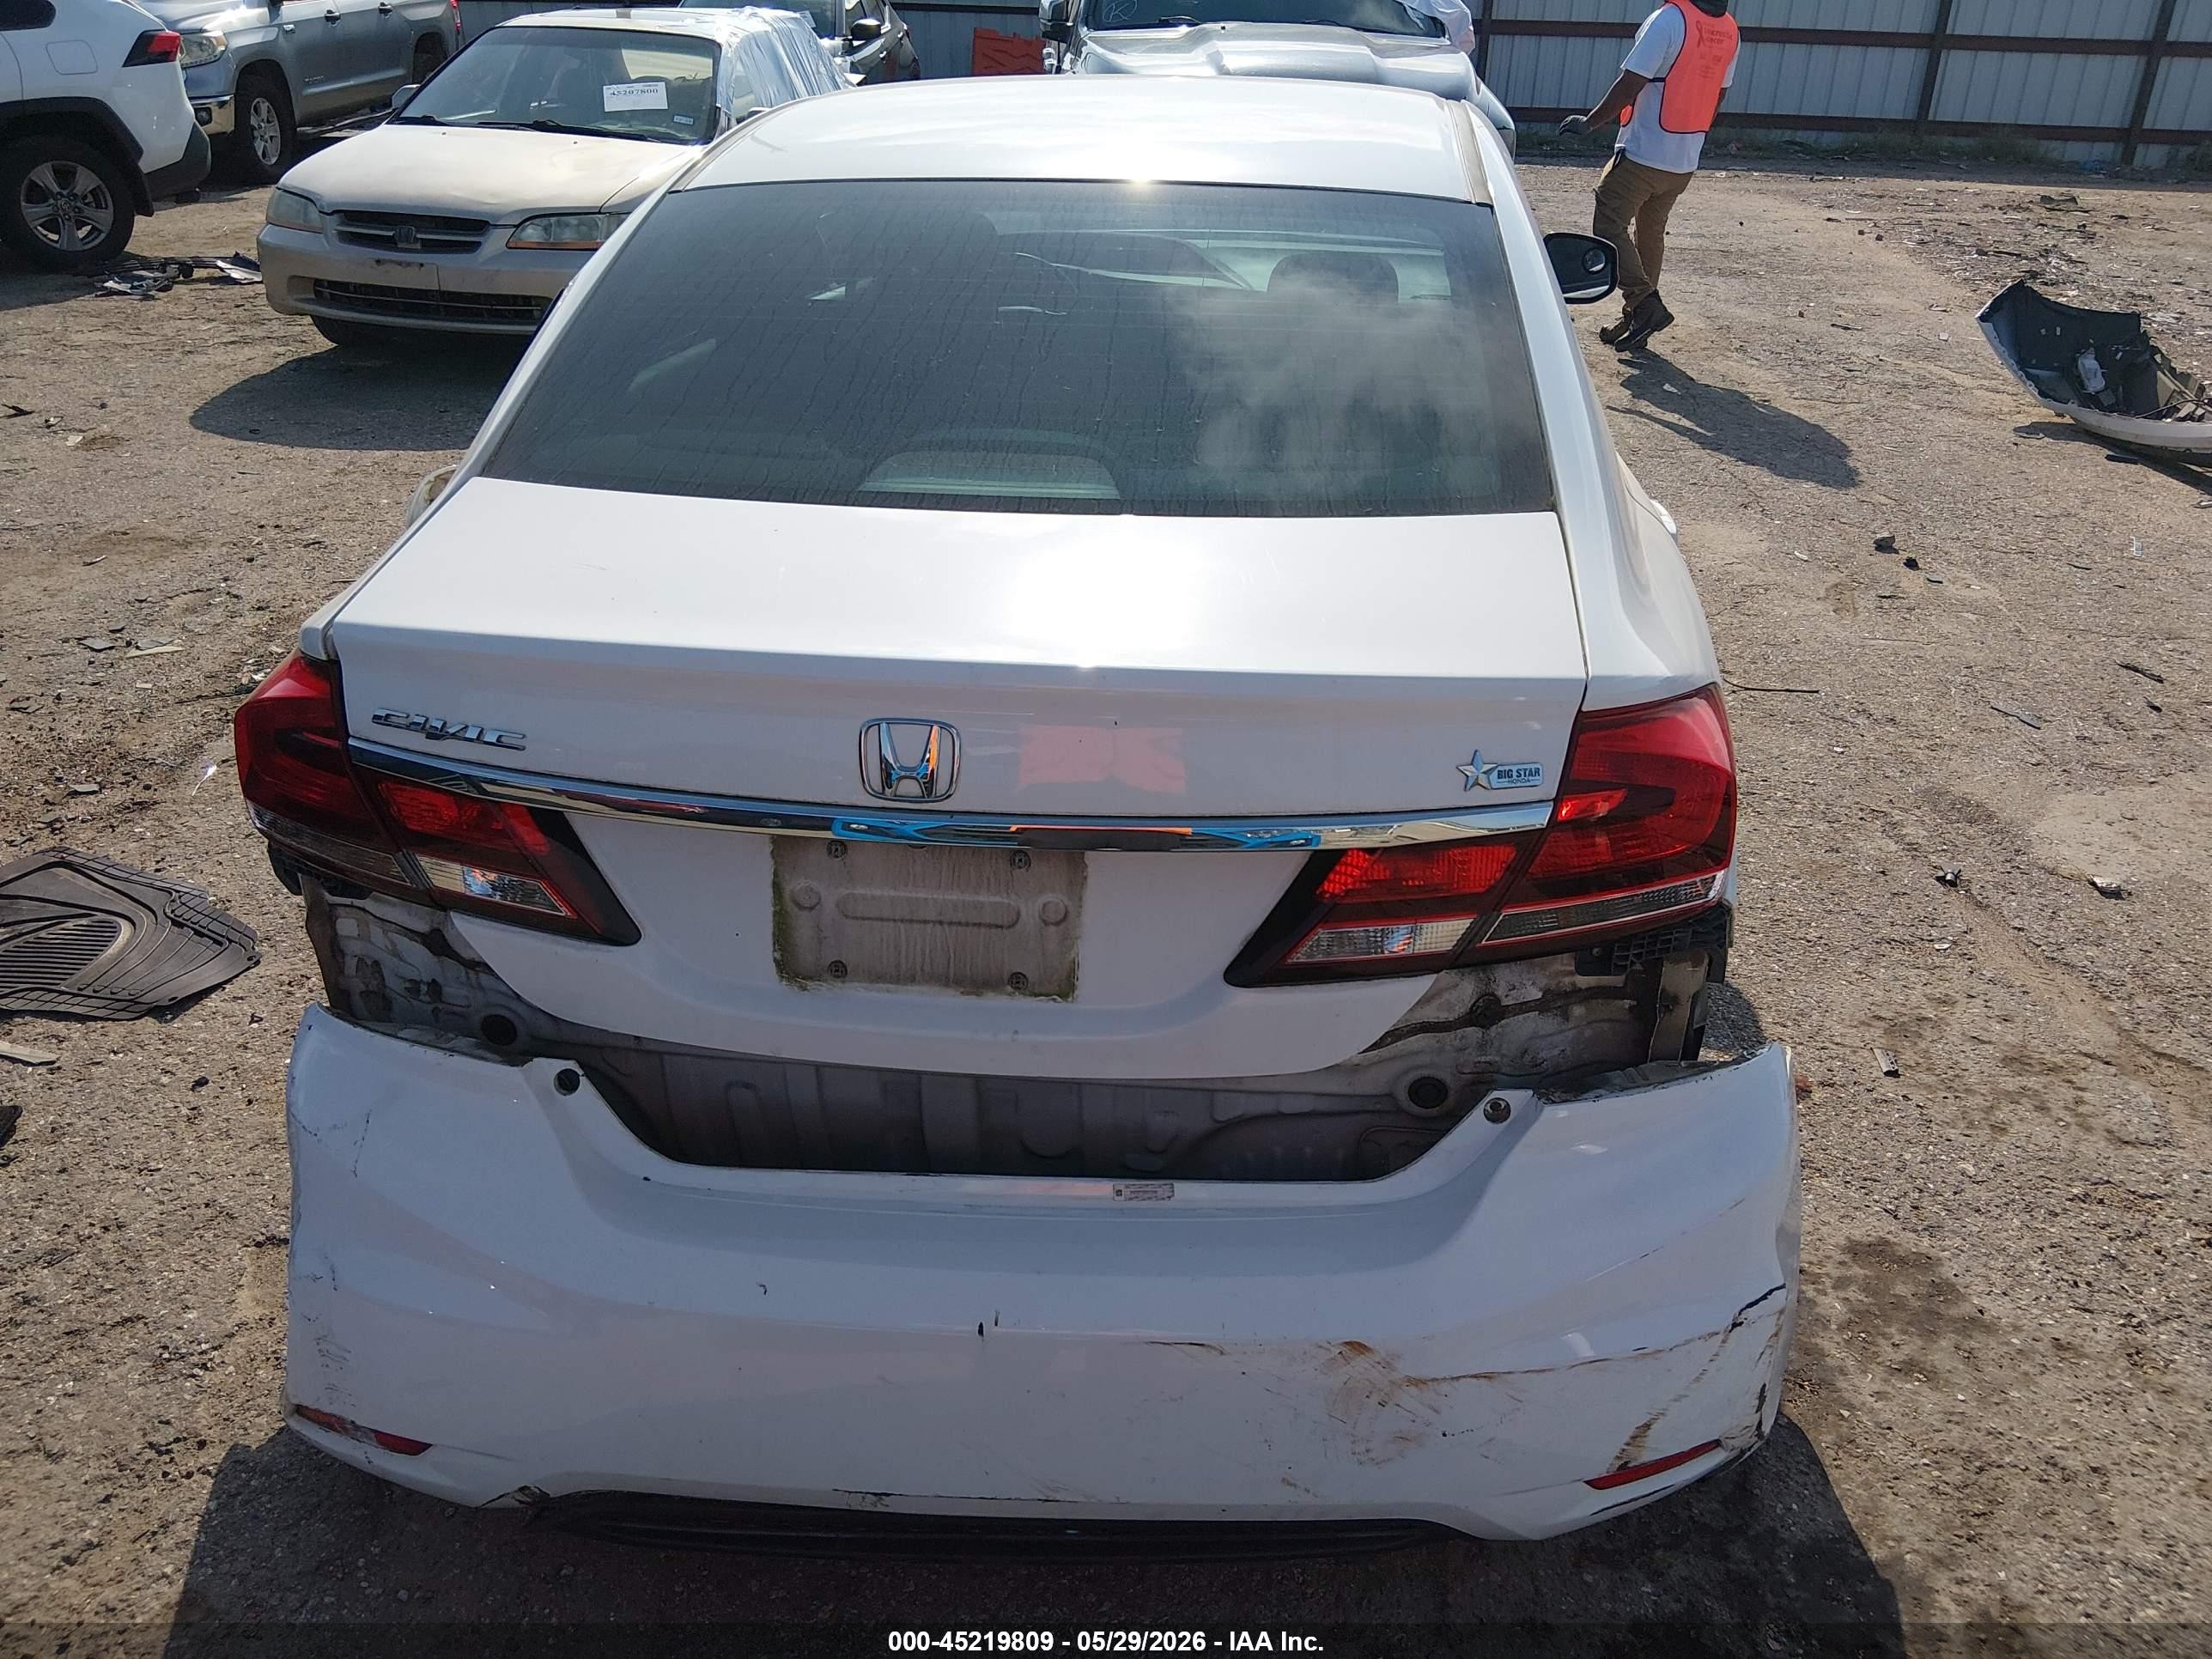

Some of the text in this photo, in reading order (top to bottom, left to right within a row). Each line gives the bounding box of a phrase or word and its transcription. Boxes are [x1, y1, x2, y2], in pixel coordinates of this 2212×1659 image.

[372, 708, 526, 751] CIVIC
[1497, 767, 1540, 780] BIG STAR
